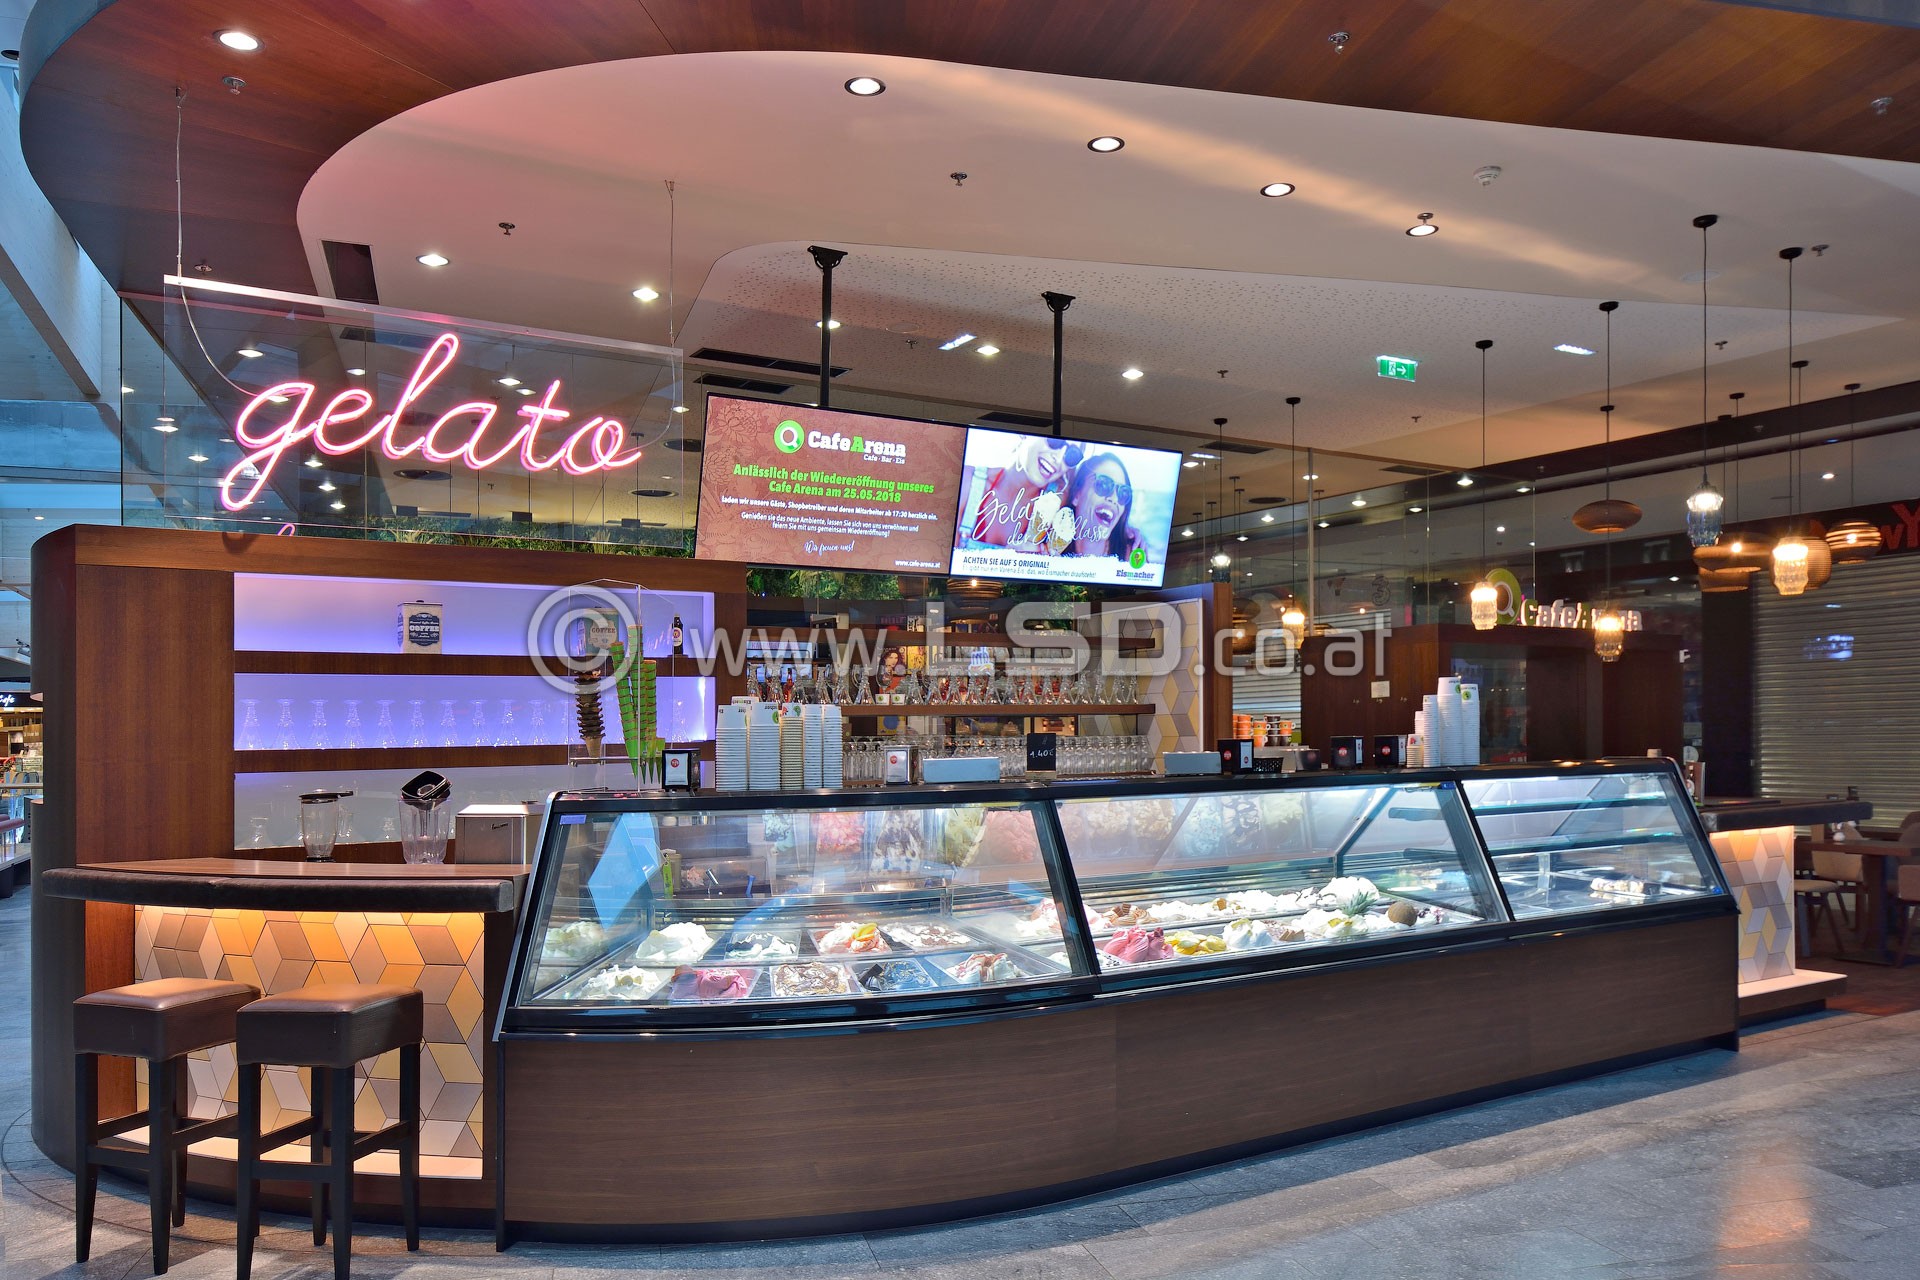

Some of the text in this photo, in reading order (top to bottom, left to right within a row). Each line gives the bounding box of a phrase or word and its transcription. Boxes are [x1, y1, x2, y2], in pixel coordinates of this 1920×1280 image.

[221, 333, 642, 511] gelato
[733, 463, 935, 493] Anlässlich der Wiedereröffnung unseres
[769, 480, 902, 503] Cafe Arena am 25.05.2018
[827, 505, 838, 513] und
[963, 556, 988, 565] ACHTEN
[989, 557, 998, 565] SIE
[1018, 560, 1050, 569] ORIGINAL!
[1116, 569, 1155, 579] Eismacher
[1520, 599, 1643, 631] CafeArna
